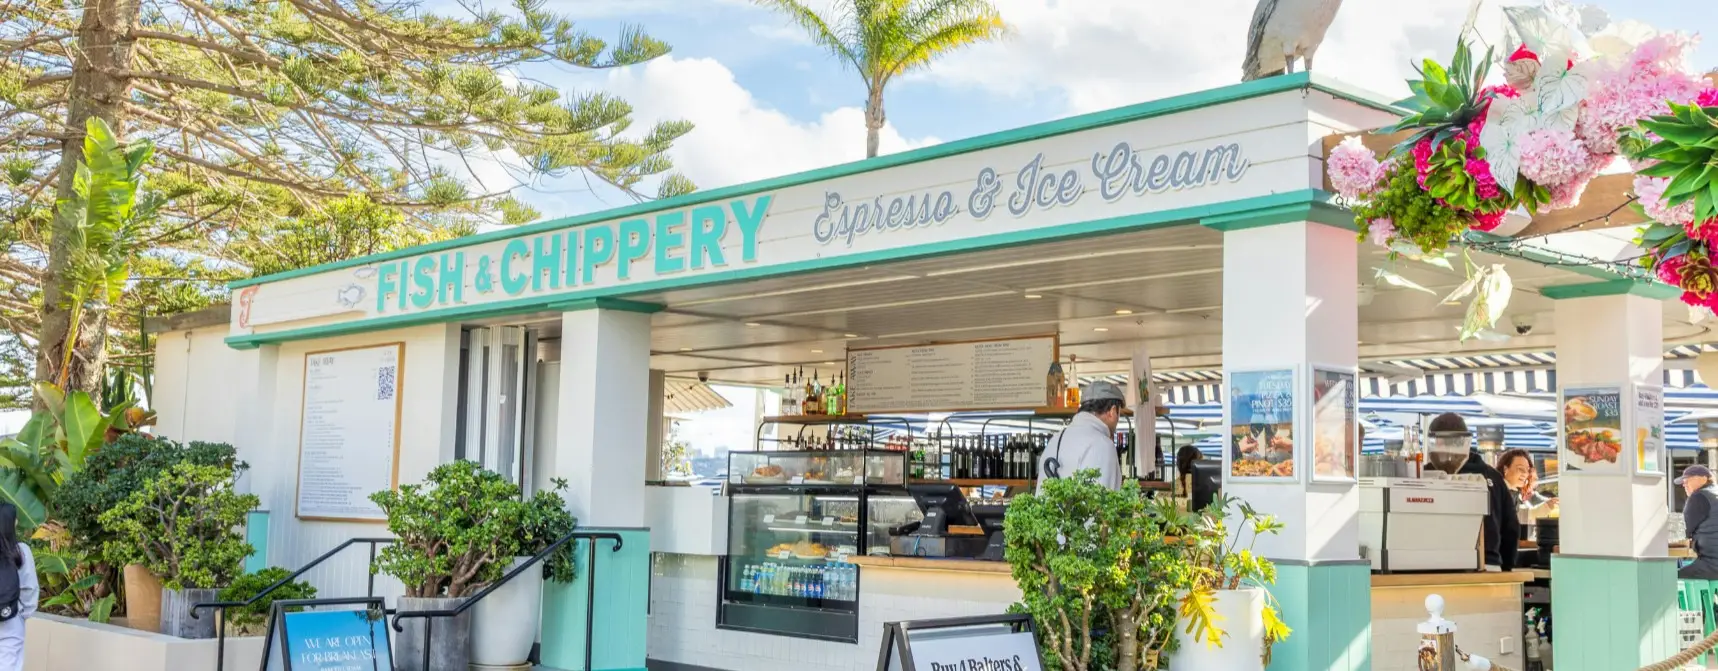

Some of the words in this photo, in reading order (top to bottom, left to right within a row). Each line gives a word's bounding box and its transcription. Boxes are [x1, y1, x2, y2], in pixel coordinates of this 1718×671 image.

[813, 189, 960, 248] Espresso
[967, 166, 1003, 219] &
[1008, 151, 1084, 217] Ice
[1092, 141, 1252, 201] Cream
[376, 251, 466, 314] FISH
[475, 254, 495, 294] &
[500, 194, 775, 296] CHIPPERY
[1588, 395, 1617, 403] SUNDAY
[1604, 408, 1619, 416] $35
[304, 637, 320, 649] WE
[326, 636, 340, 648] ARE
[344, 634, 372, 647] OPEN
[301, 651, 321, 664] FOR
[322, 648, 376, 663] BREAKFAST
[967, 656, 1013, 671] Balters
